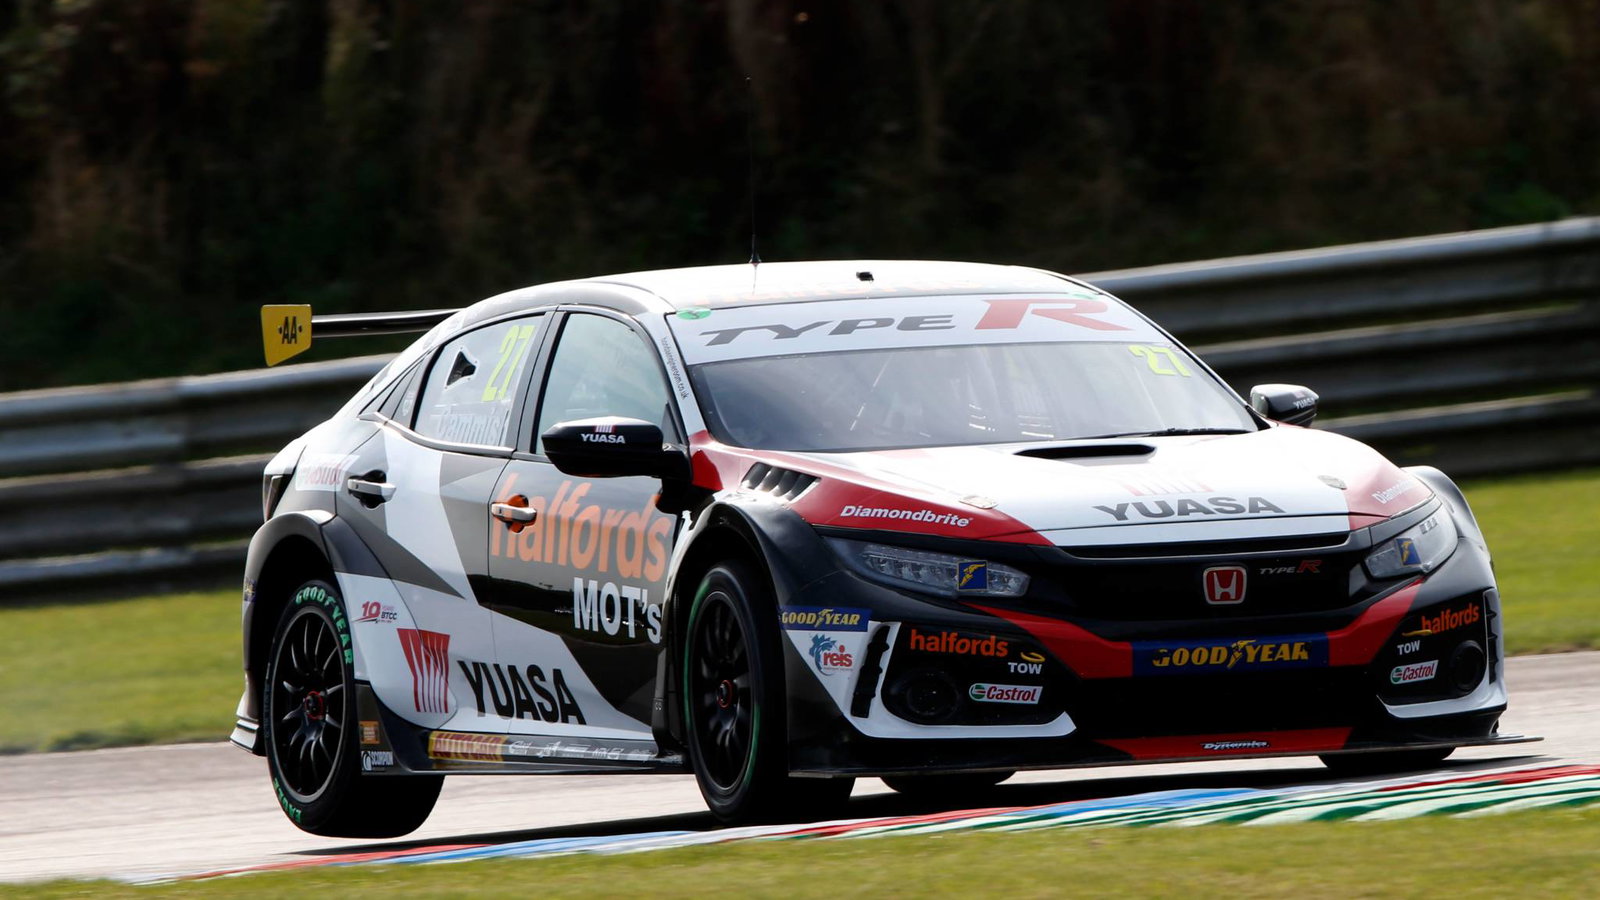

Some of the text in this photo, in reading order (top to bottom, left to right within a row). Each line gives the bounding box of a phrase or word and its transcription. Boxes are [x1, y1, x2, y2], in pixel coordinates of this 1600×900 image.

[700, 299, 1136, 347] TYPE R
[481, 324, 536, 402] 27
[1128, 345, 1192, 377] 27
[580, 433, 626, 444] YUASA
[840, 505, 970, 528] Diamondbrite
[1092, 496, 1287, 522] YUASA
[491, 472, 674, 583] halfords
[1259, 560, 1323, 575] TYPE R
[362, 600, 382, 618] 10
[381, 611, 398, 620] BTCC
[573, 577, 662, 644] MOT's
[1421, 603, 1480, 634] halfords
[910, 629, 1009, 658] halfords
[1397, 640, 1420, 656] TOW
[823, 644, 853, 668] reis
[1008, 662, 1042, 675] TOW
[1402, 662, 1435, 681] Castrol
[456, 659, 587, 726] YUASA
[986, 685, 1037, 701] Castrol
[1203, 740, 1268, 750] Dynamics
